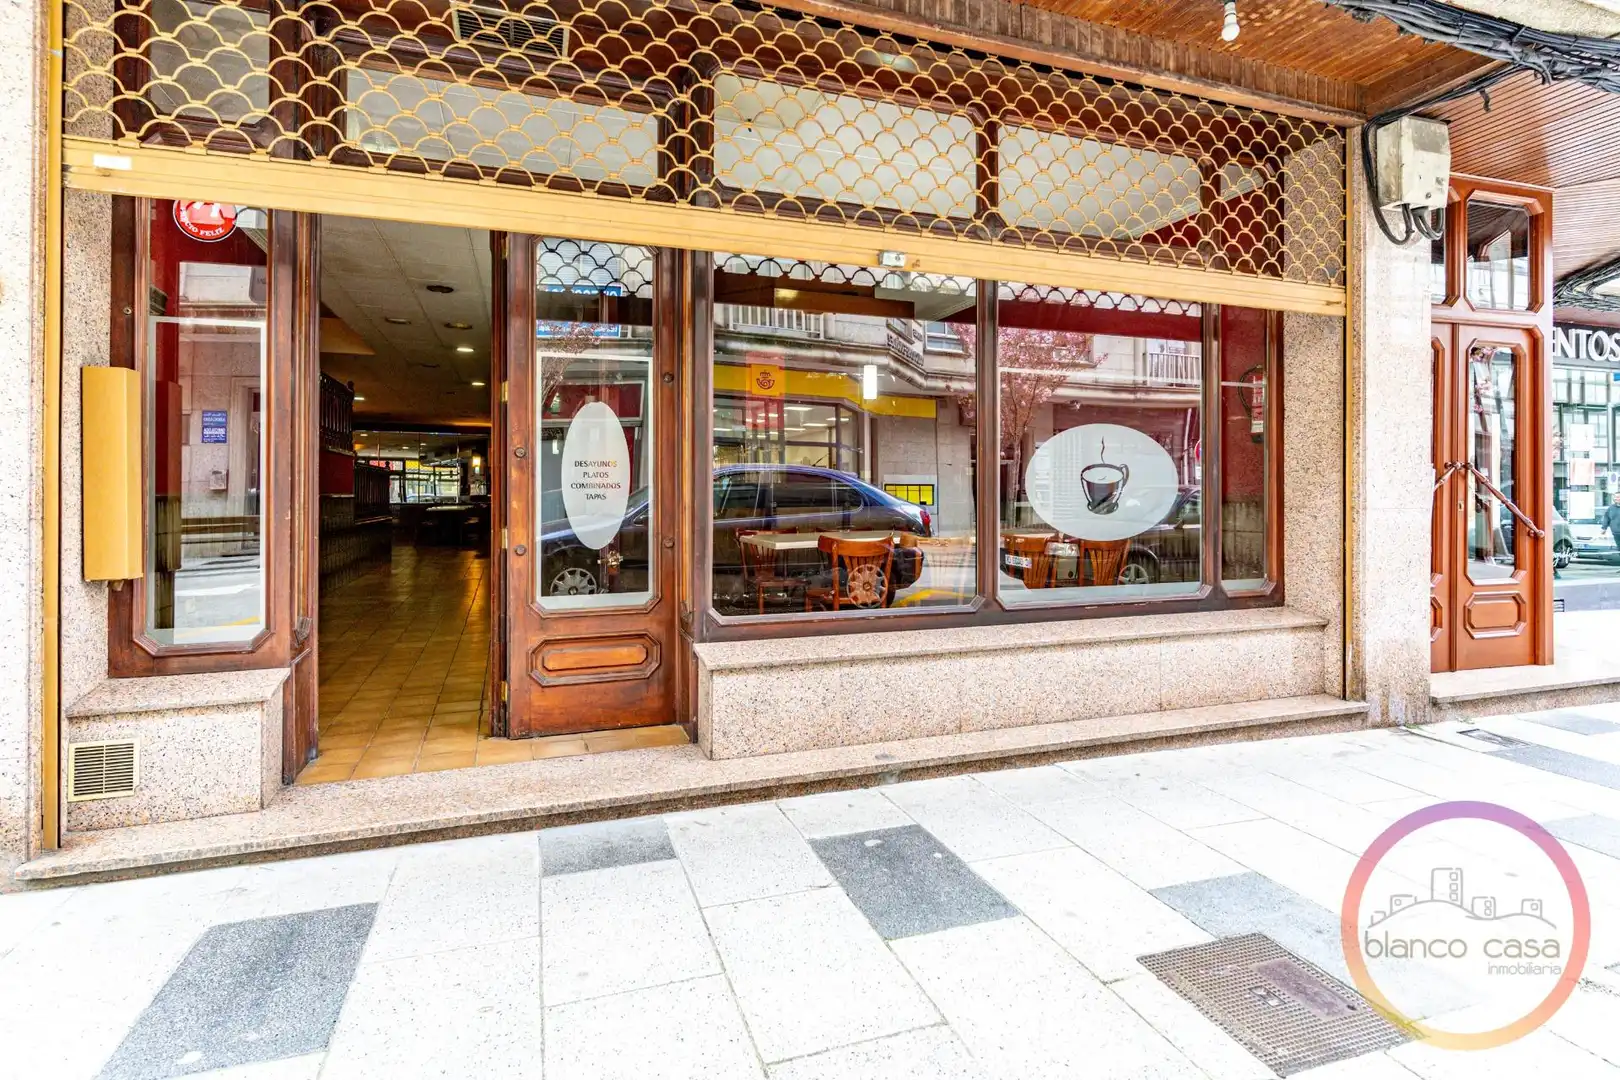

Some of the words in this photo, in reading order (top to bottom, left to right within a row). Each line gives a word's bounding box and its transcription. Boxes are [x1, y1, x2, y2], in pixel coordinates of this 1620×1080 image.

[199, 228, 225, 237] FELIZ
[1552, 326, 1620, 362] NTOS
[574, 460, 618, 468] DESAYUNOS
